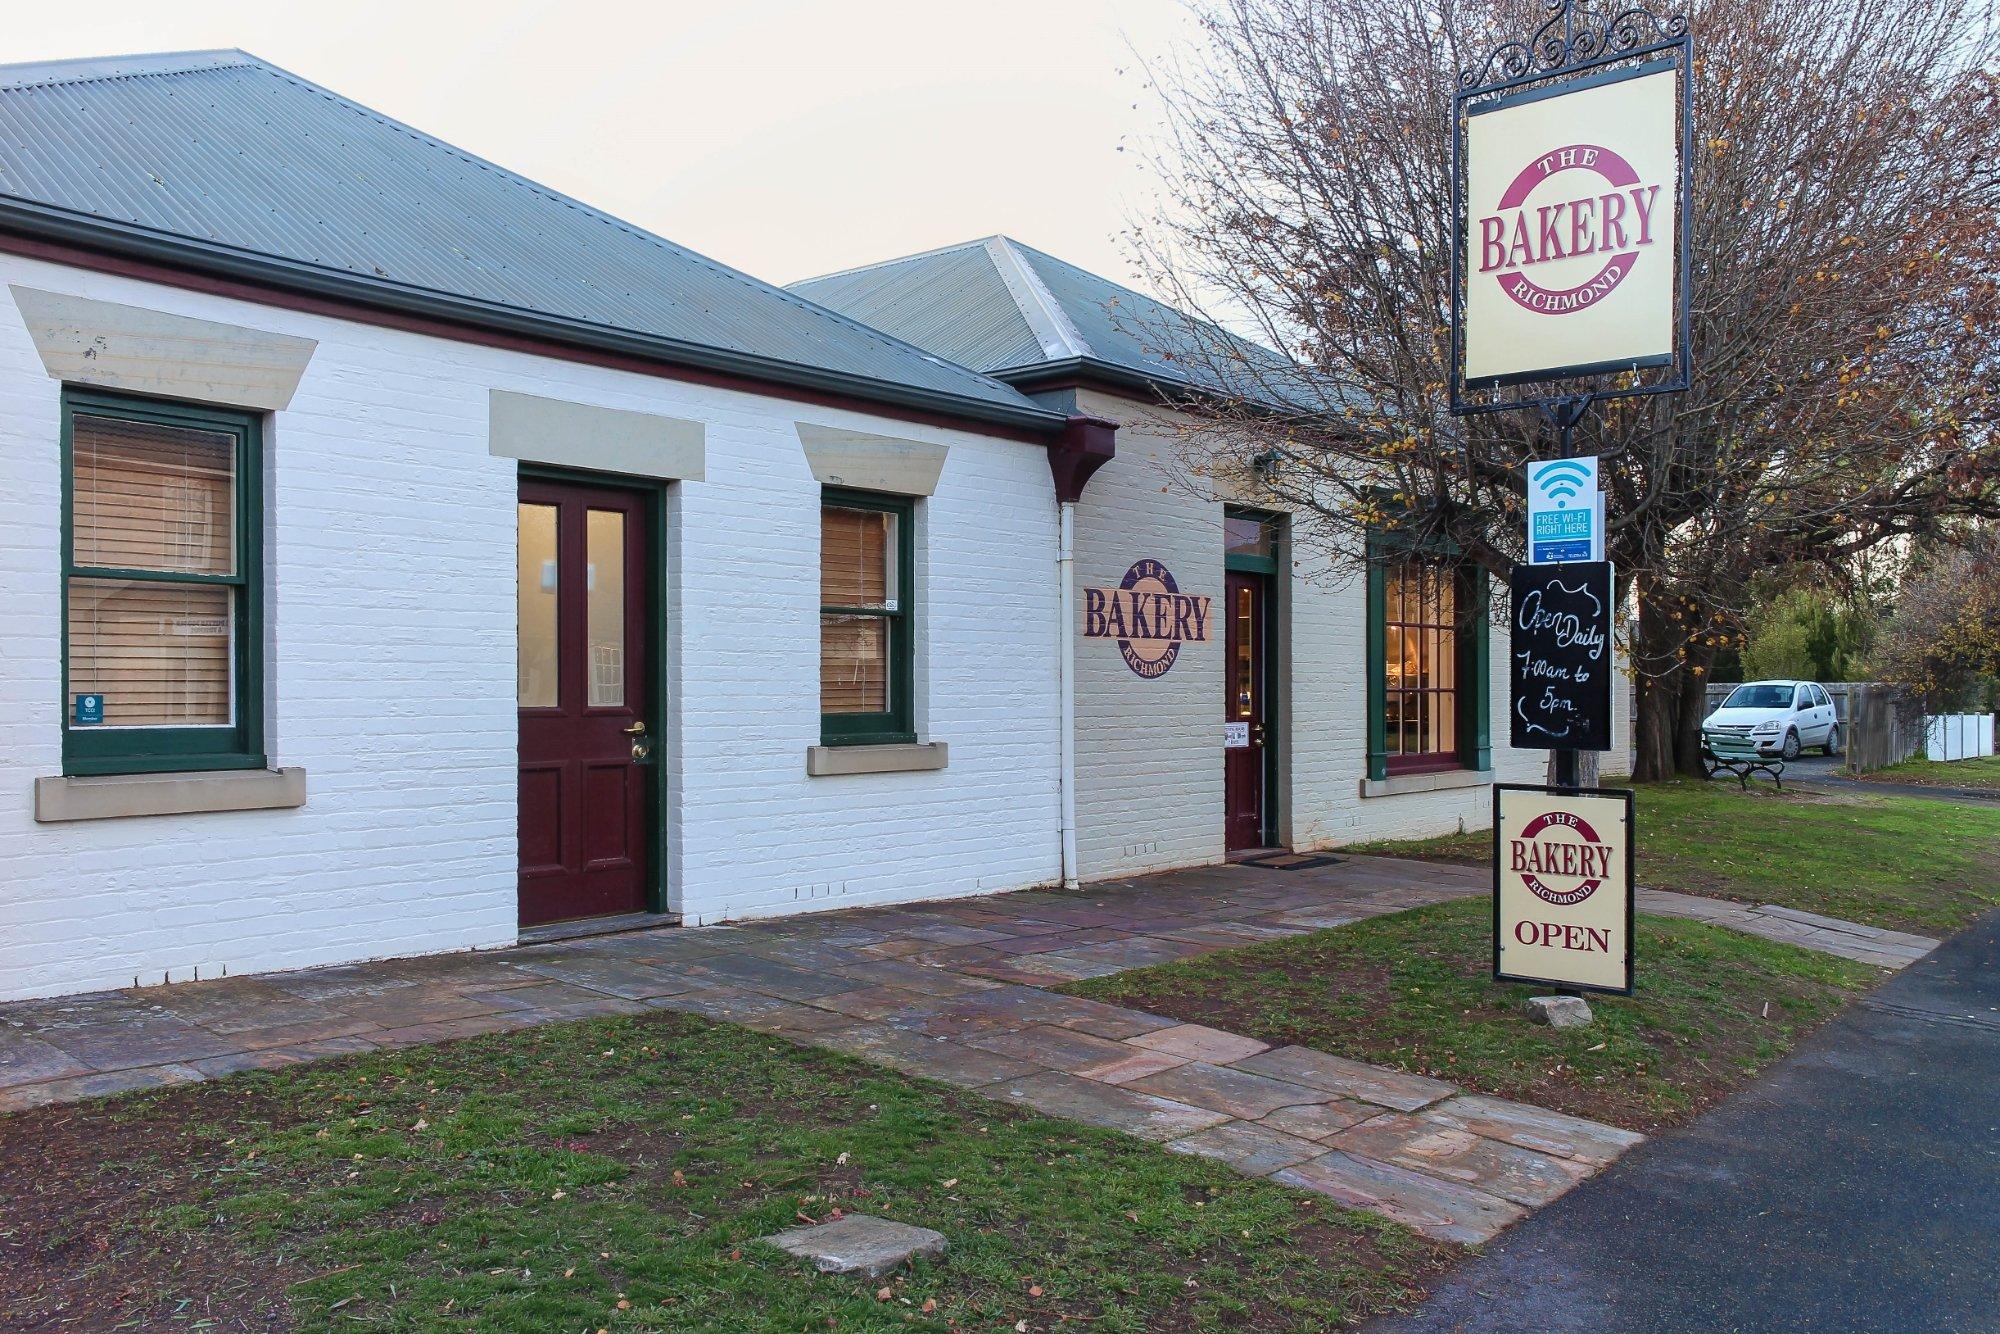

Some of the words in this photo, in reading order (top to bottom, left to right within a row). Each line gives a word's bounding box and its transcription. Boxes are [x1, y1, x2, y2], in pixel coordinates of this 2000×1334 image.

[1537, 148, 1599, 176] THE
[1479, 184, 1660, 273] BAKERY
[1512, 264, 1621, 311] RICHMOND
[1536, 514, 1559, 525] FREE
[1562, 512, 1586, 523] WI-FI
[1536, 524, 1562, 535] RIGHT
[1564, 522, 1588, 534] HERE
[1132, 562, 1167, 582] THE
[1083, 588, 1211, 641] BAKERY
[1519, 590, 1564, 635] Open
[1557, 614, 1605, 660] Daily
[1124, 646, 1175, 677] RICHMOND
[1574, 664, 1590, 683] to
[1543, 813, 1579, 828] THE
[1510, 840, 1613, 878] BAKERY
[1529, 880, 1592, 904] RICHMOND
[1514, 920, 1611, 954] OPEN
